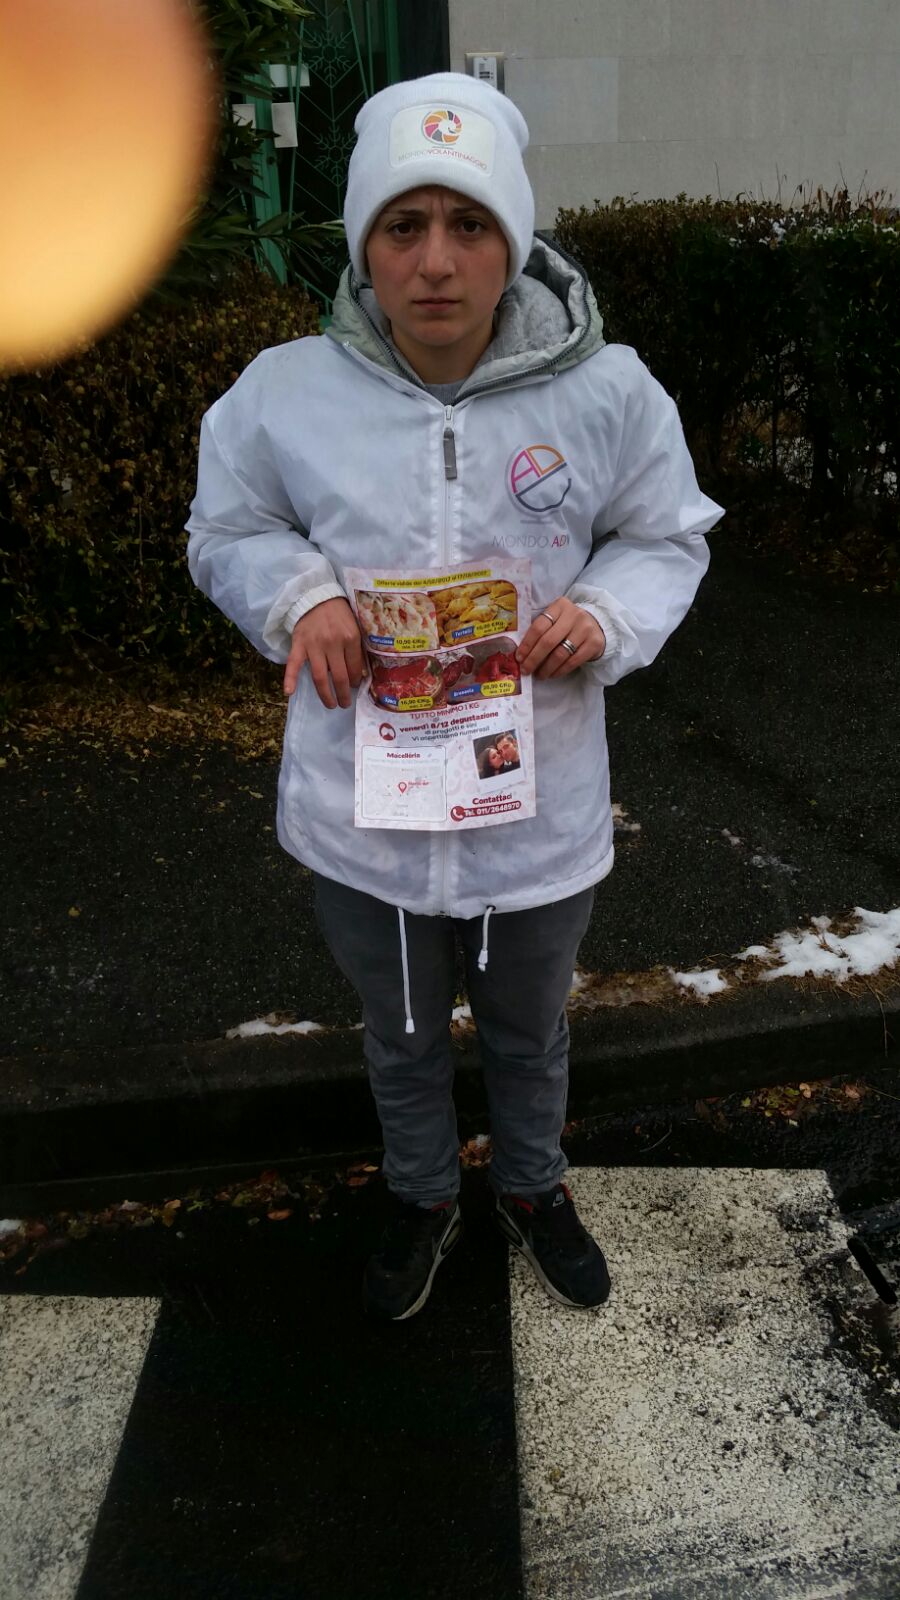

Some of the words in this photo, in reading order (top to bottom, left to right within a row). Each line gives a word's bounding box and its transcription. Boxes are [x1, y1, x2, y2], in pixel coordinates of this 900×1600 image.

[492, 535, 549, 548] MONDO
[410, 711, 436, 719] TUTTO
[436, 705, 464, 717] MINIMO
[469, 702, 480, 710] KG
[399, 723, 429, 733] venerdì
[450, 711, 499, 725] degustazione
[432, 725, 460, 735] prodotti
[472, 792, 513, 805] Contattaci
[476, 801, 520, 815] 011/2648970
